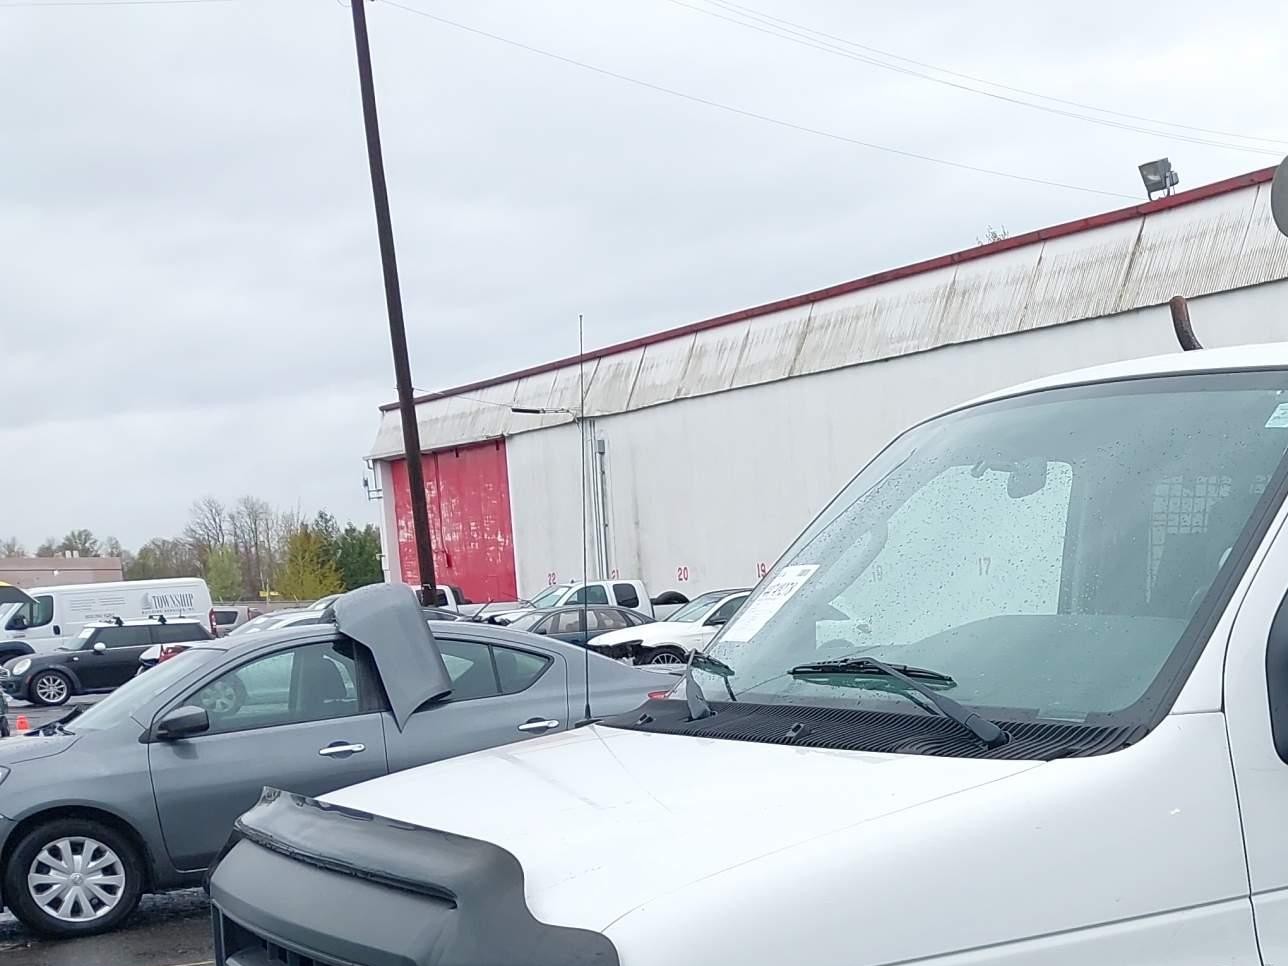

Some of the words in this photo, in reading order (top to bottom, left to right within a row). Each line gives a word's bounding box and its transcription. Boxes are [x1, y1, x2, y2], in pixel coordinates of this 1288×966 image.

[677, 566, 689, 581] 20
[978, 557, 992, 576] 17
[547, 572, 557, 586] 22
[152, 593, 194, 609] TOWNSHIP
